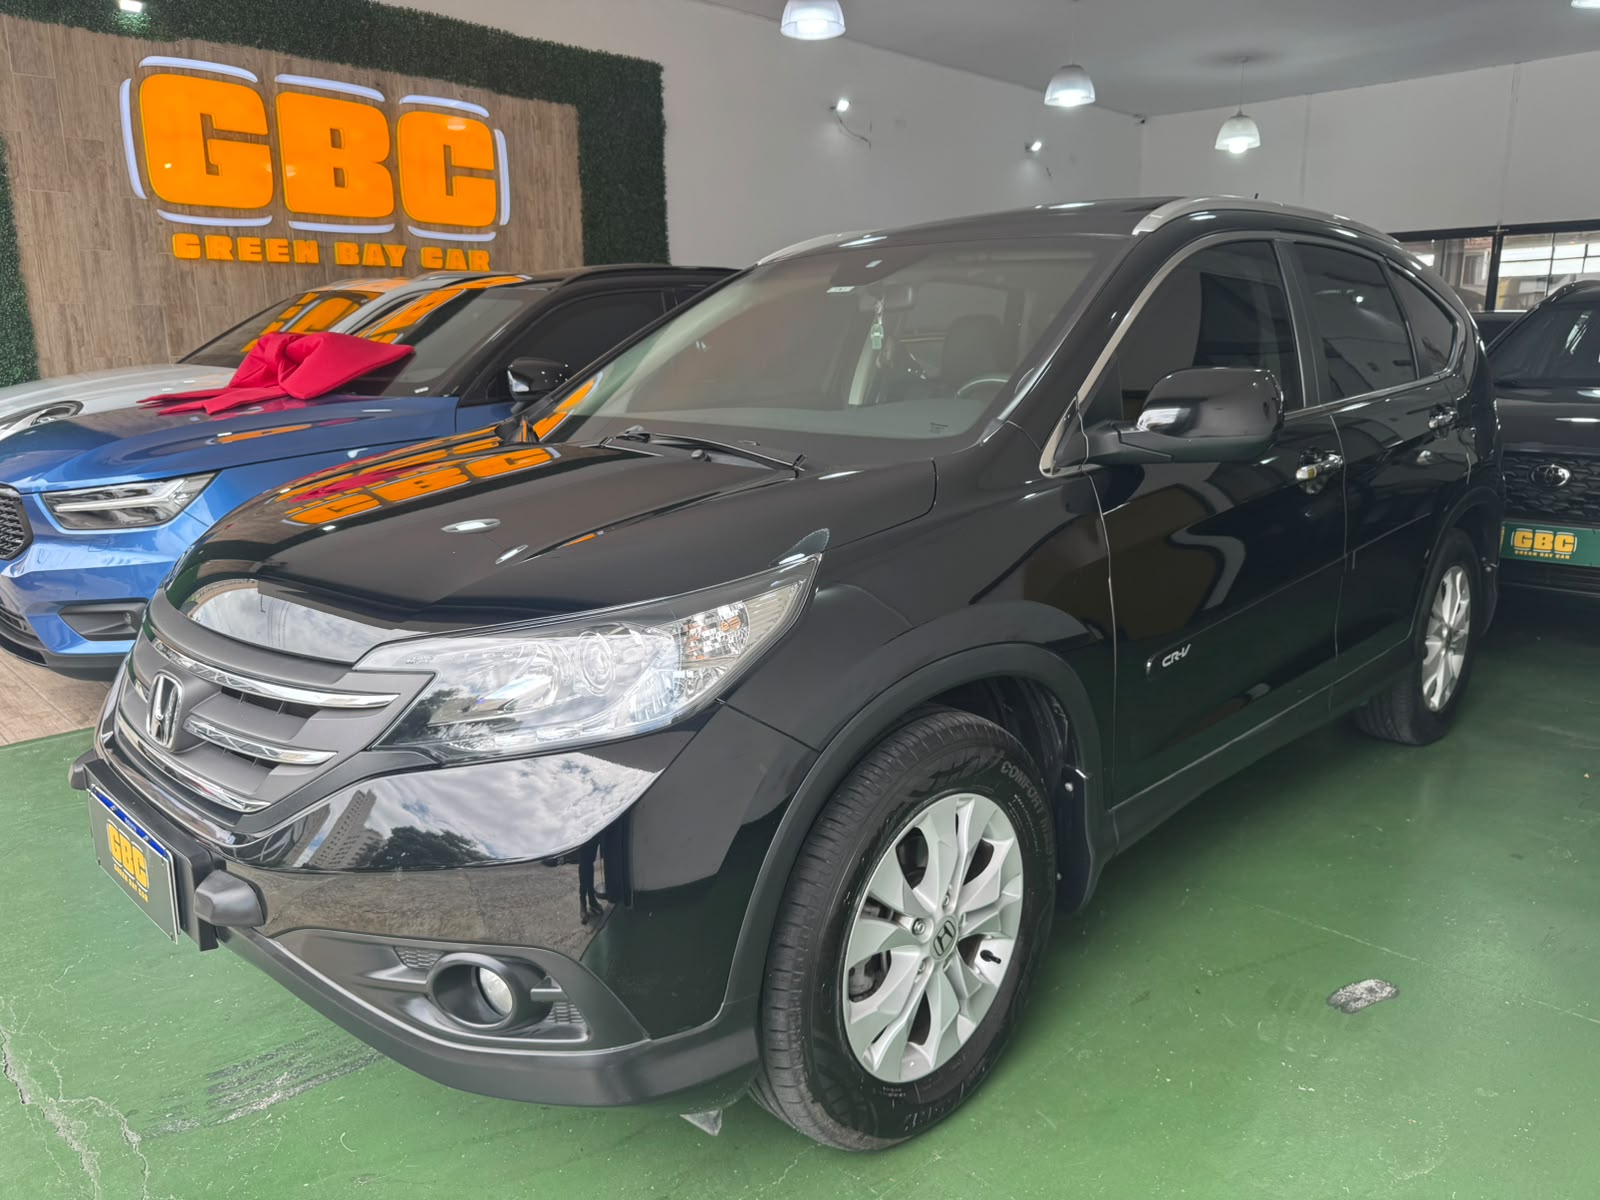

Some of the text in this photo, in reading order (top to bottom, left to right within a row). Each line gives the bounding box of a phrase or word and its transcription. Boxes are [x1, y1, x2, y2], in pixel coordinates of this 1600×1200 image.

[139, 73, 497, 227] GBC
[172, 232, 490, 271] GREEN BAY CAR
[1514, 531, 1575, 552] GBC
[108, 822, 148, 889] GBC
